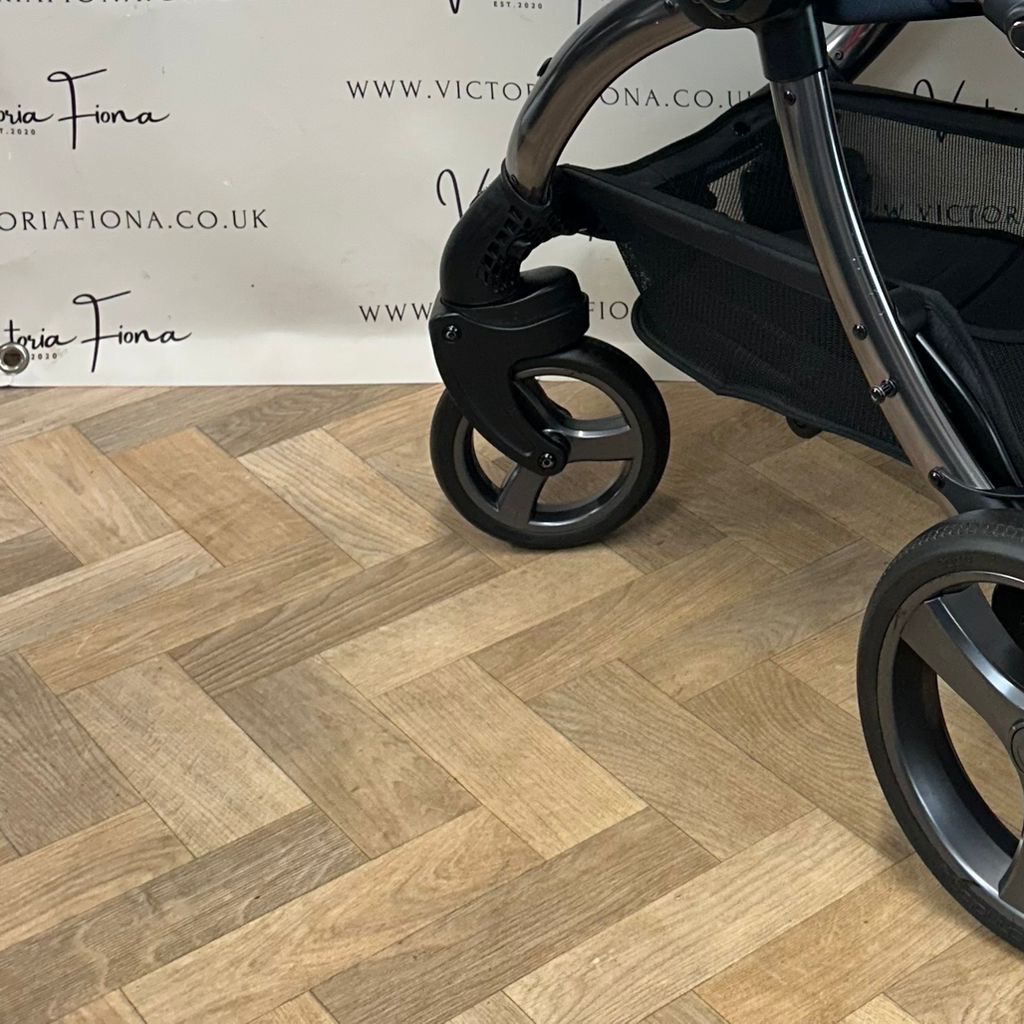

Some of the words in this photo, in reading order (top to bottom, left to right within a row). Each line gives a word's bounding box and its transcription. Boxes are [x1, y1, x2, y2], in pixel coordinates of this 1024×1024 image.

[493, 0, 543, 10] EST.2020
[47, 68, 170, 150] Fiona
[72, 290, 193, 374] Fiona
